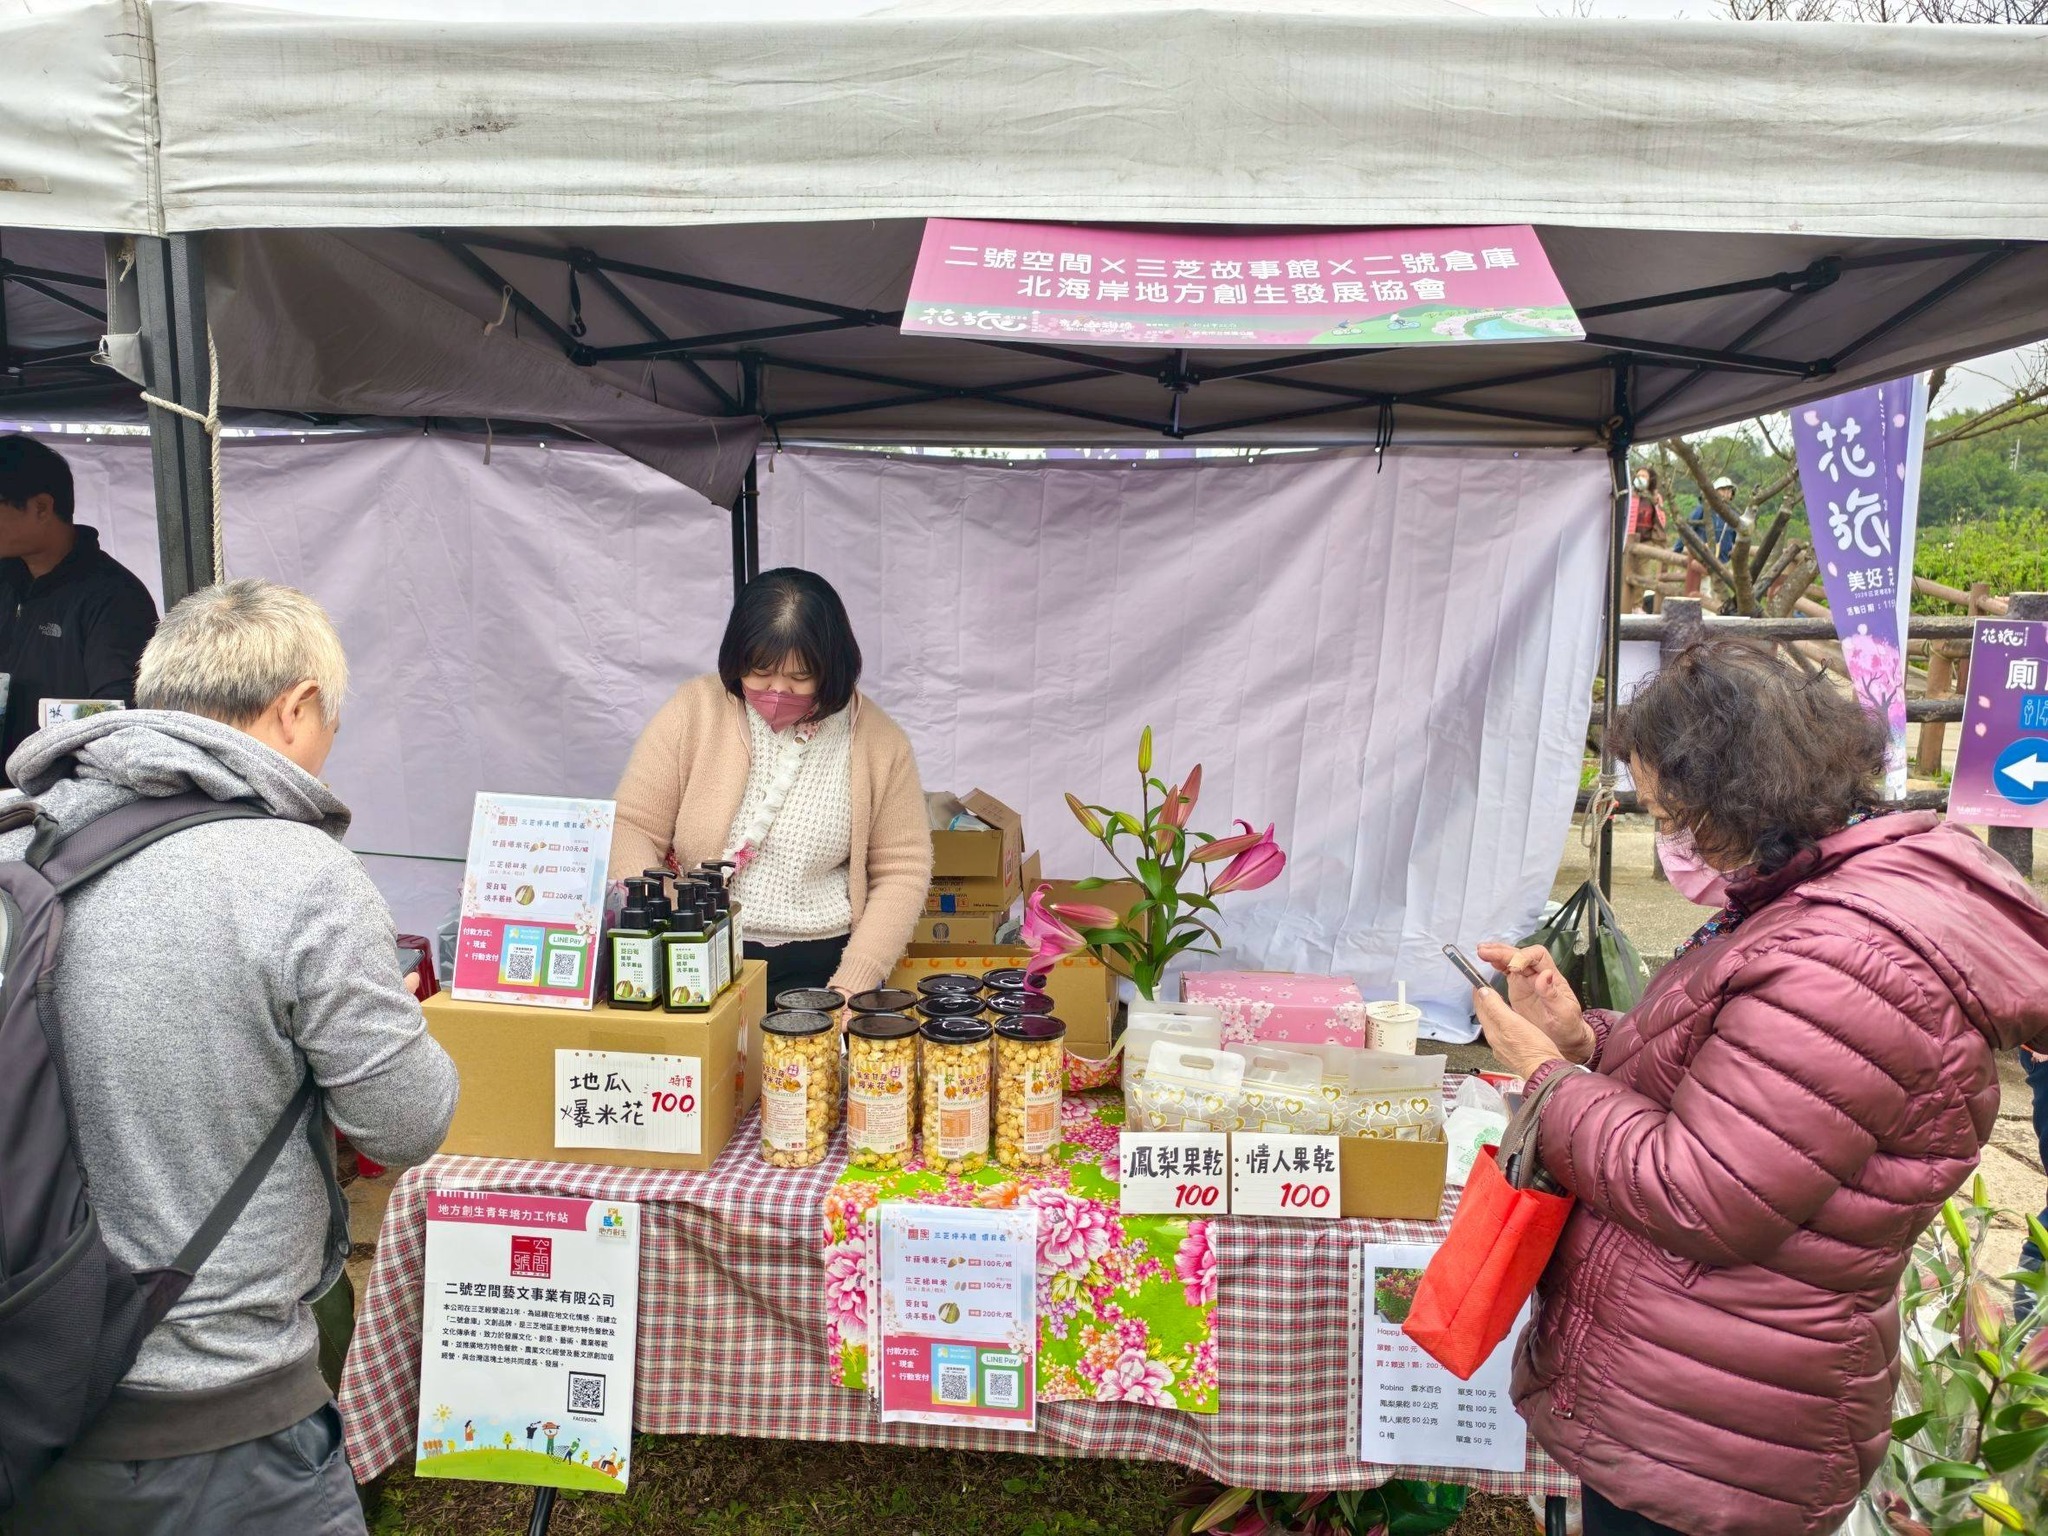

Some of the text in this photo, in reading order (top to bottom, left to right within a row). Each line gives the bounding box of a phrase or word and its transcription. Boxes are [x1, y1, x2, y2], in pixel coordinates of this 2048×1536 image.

[1017, 275, 1445, 305] 北海岸地方創生發展協會
[1847, 566, 1895, 592] 美好
[2005, 658, 2048, 691] 廁
[473, 941, 487, 949] 現金
[472, 953, 499, 962] 行動支付
[569, 1072, 632, 1094] 地瓜
[668, 1075, 694, 1088] 特價
[651, 1091, 695, 1113] 100
[560, 1098, 644, 1129] 爆米花
[1129, 1145, 1224, 1179] 鳳梨果乾
[1246, 1143, 1336, 1174] 情人果乾
[1175, 1184, 1219, 1208] 100
[1280, 1182, 1330, 1208] 100
[437, 1203, 569, 1224] 地方創生青年培力工作站
[598, 1227, 627, 1238] 地方創生
[444, 1282, 615, 1308] 二號空間藝文事業有限公司
[1376, 1328, 1400, 1337] Happy
[1410, 1345, 1418, 1353] 元
[898, 1360, 915, 1368] 現金
[1004, 1357, 1018, 1365] Pay
[899, 1372, 930, 1381] 行動支付
[1380, 1383, 1404, 1391] Robina
[1410, 1384, 1442, 1394] 香水百合
[1488, 1390, 1497, 1398] 元
[1422, 1401, 1439, 1410] 公克
[1488, 1406, 1497, 1414] 元
[1422, 1416, 1439, 1426] 公克
[1488, 1422, 1497, 1430] 元
[1473, 1436, 1482, 1444] 50
[1484, 1437, 1492, 1445] 元
